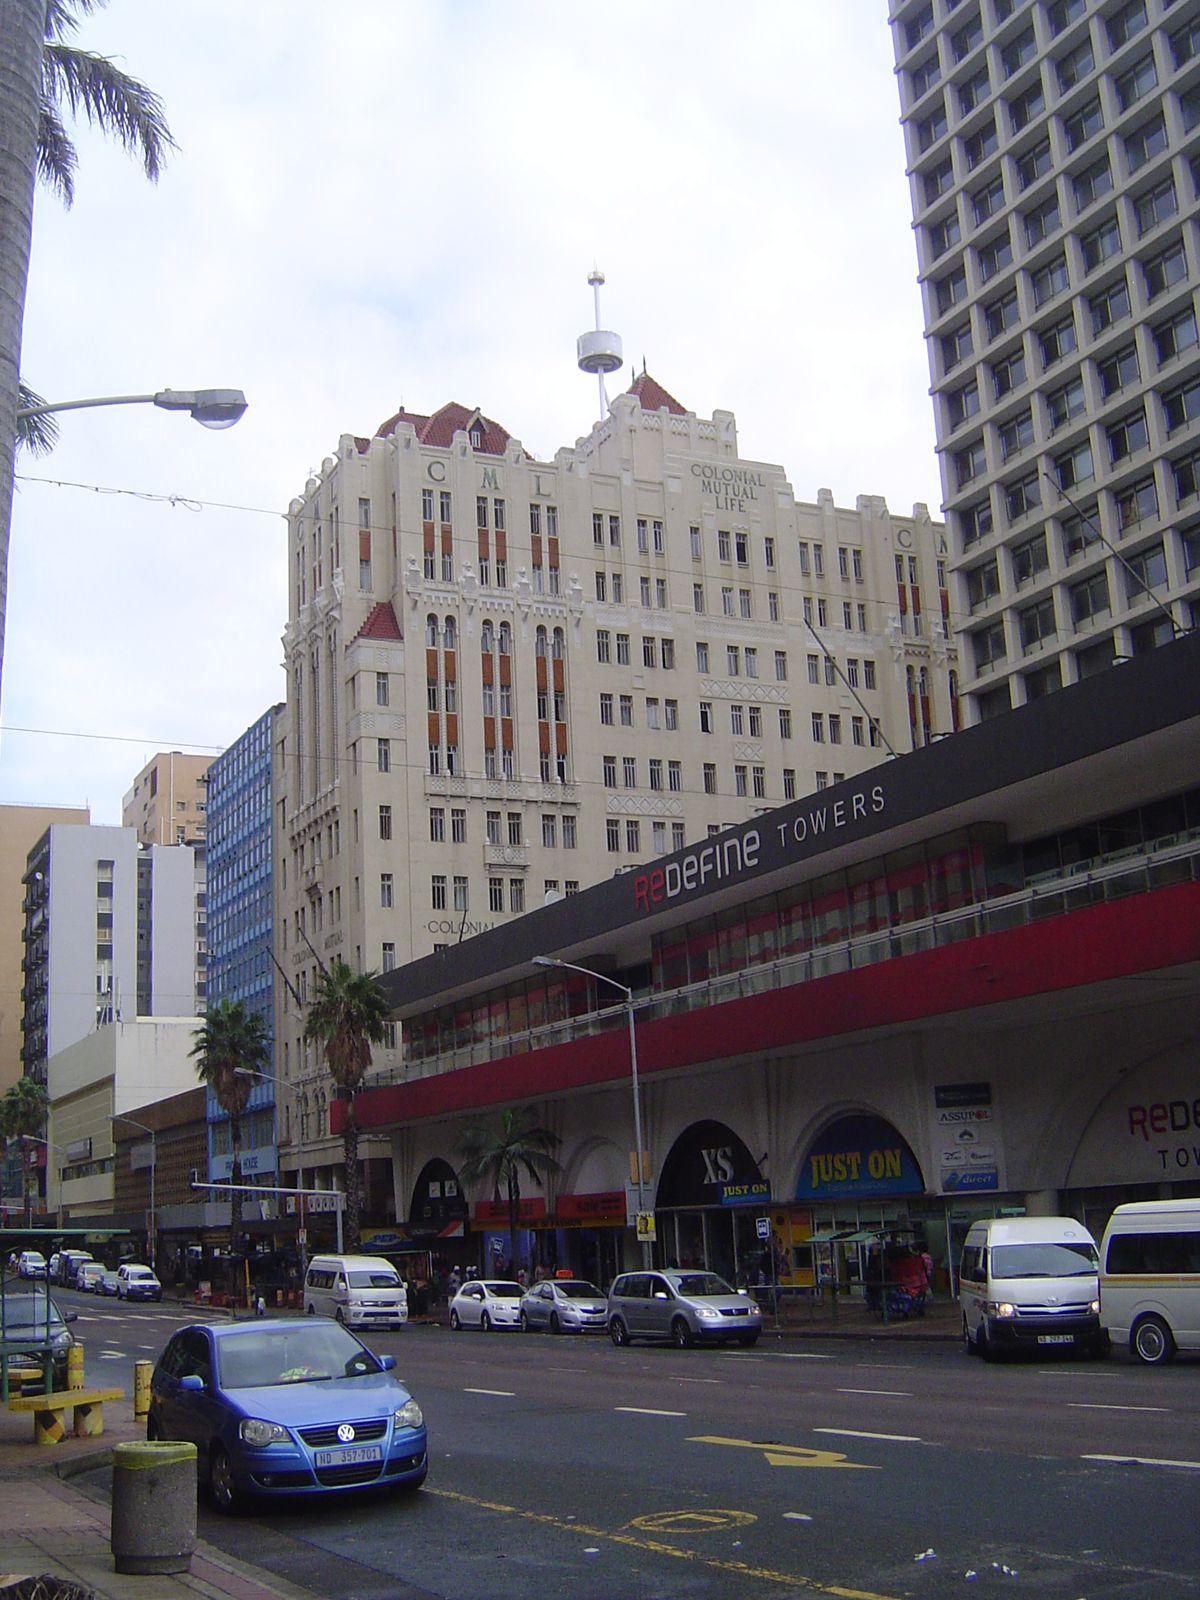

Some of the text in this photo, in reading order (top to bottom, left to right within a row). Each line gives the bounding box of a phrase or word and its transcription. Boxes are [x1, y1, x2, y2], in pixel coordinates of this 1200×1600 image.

[427, 460, 552, 497] C M L
[690, 463, 767, 488] COLONIAL
[701, 479, 758, 501] MUTUAL
[715, 495, 746, 513] LIFE
[897, 529, 913, 549] C
[776, 785, 885, 848] TOWERS
[701, 1146, 734, 1184] XS
[810, 1149, 902, 1190] JUST ON
[723, 1183, 768, 1198] JUST ON
